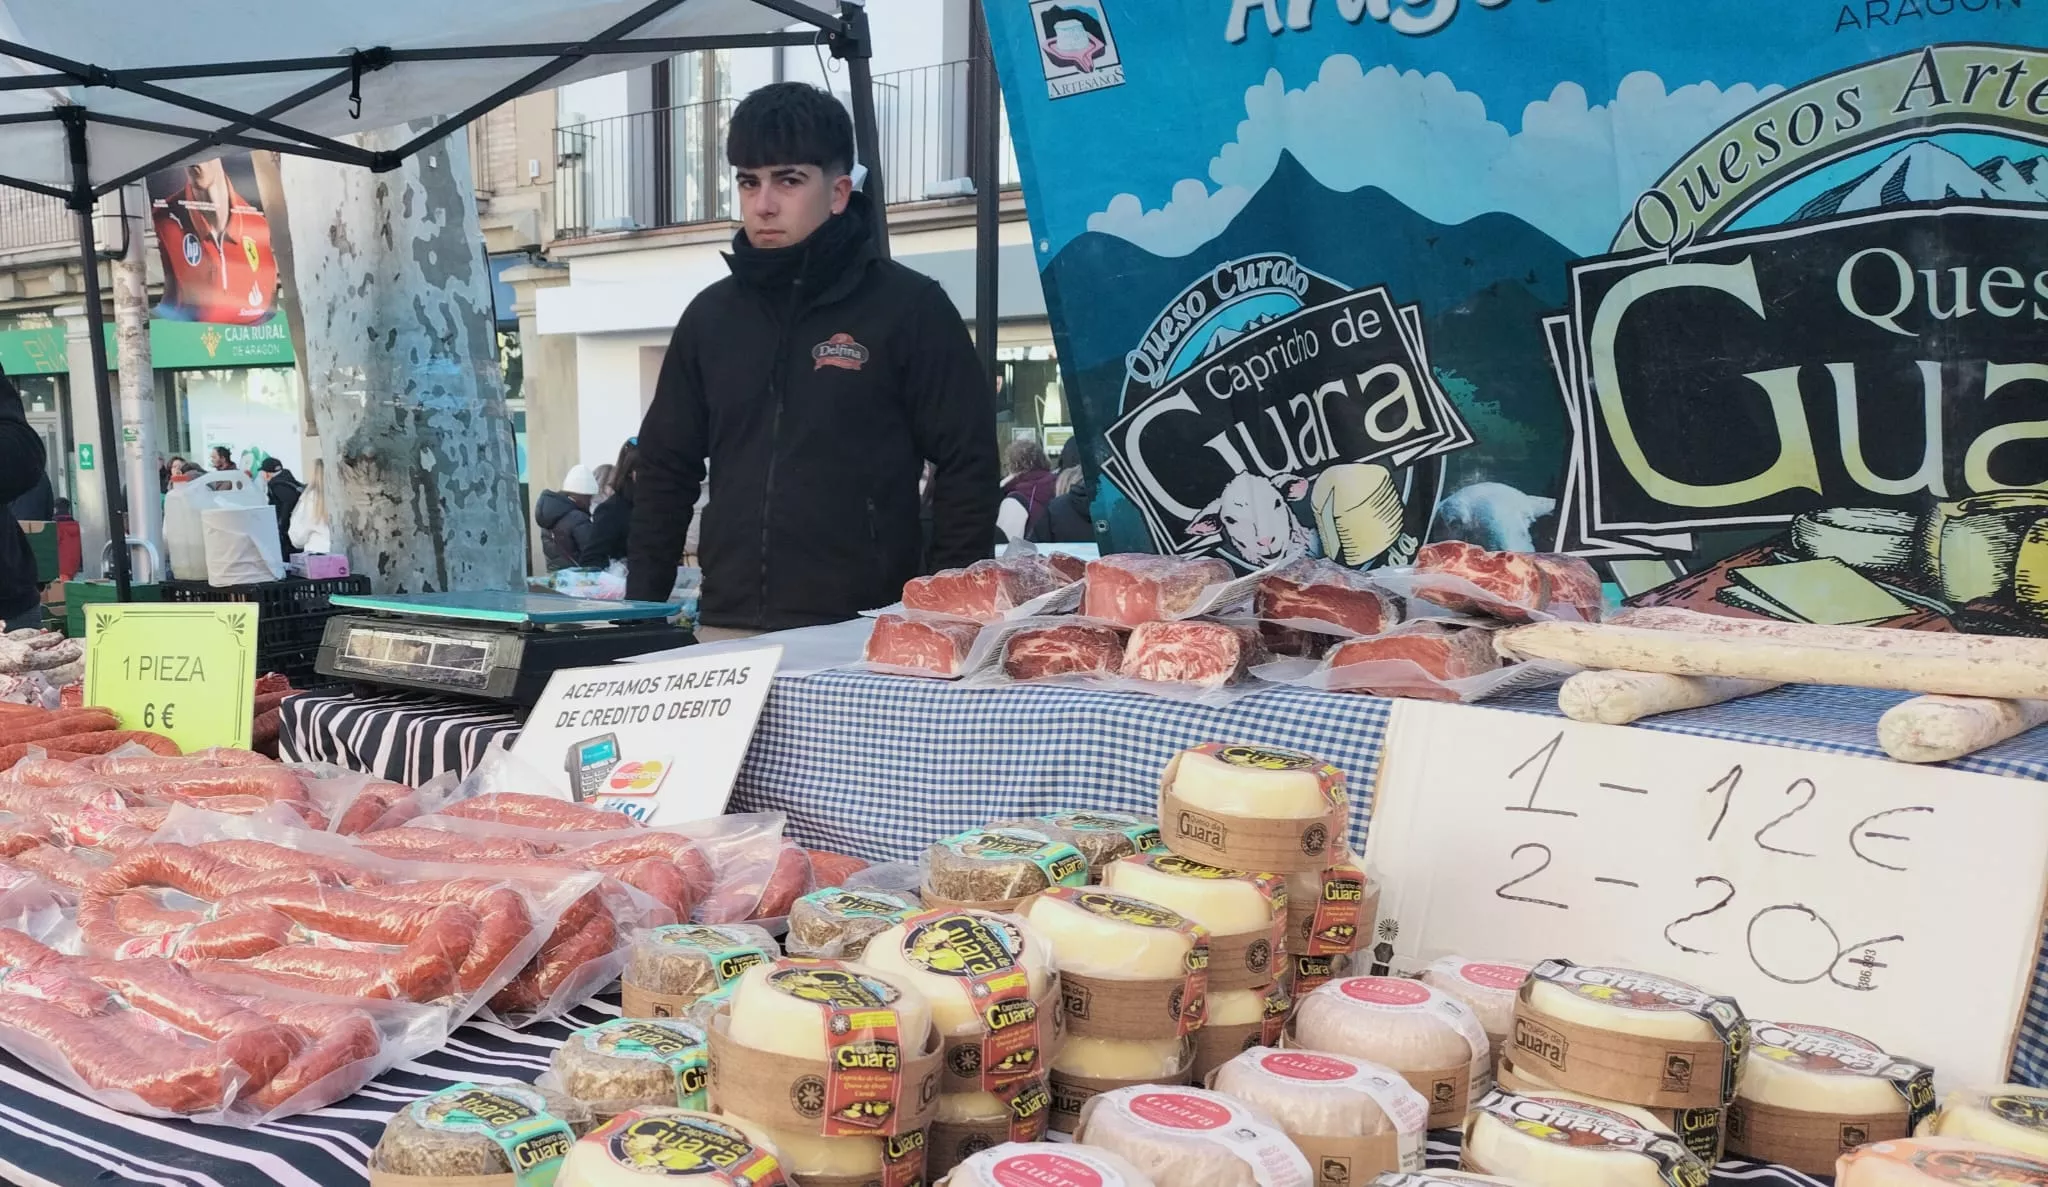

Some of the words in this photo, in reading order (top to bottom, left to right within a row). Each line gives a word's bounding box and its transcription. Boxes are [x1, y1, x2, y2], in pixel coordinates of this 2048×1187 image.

[1634, 85, 1862, 264] Quesos
[224, 327, 251, 342] CAJA
[252, 323, 286, 341] RURAL
[1126, 292, 1207, 390] Queso
[1213, 256, 1309, 300] Curado
[232, 346, 244, 356] DE
[1205, 330, 1320, 401] Capricho
[1331, 307, 1382, 348] de
[1125, 363, 1427, 521] Guara
[123, 655, 130, 680] 1
[139, 655, 206, 682] PIEZA
[562, 676, 663, 699] ACEPTAMOS
[664, 666, 751, 692] TARJETAS
[144, 702, 155, 728] 6
[161, 702, 175, 729] €
[555, 711, 580, 728] DE
[580, 704, 650, 727] CREDITO
[652, 703, 664, 721] O
[667, 698, 732, 720] DEBITO
[1505, 731, 1578, 817] 1
[1179, 811, 1221, 846] Guara
[1049, 858, 1085, 881] Guara
[1496, 843, 1568, 909] 2
[1325, 881, 1361, 900] Guara
[934, 915, 997, 975] Guara
[1350, 981, 1421, 999] Guara
[986, 1004, 1035, 1030] Guara
[1525, 1021, 1550, 1038] Queso
[1551, 1032, 1563, 1043] de
[1514, 1018, 1561, 1062] Guara
[1756, 1026, 1875, 1070] Guara
[837, 1045, 897, 1067] Guara
[1273, 1056, 1345, 1077] Guara
[1011, 1092, 1048, 1117] Guara
[1145, 1096, 1215, 1127] Guara
[1510, 1100, 1638, 1146] Guara
[515, 1138, 573, 1168] Guara
[628, 1116, 739, 1167] Guara
[677, 1125, 730, 1147] Capricho
[730, 1140, 749, 1155] de
[888, 1131, 924, 1158] Guara
[1010, 1160, 1083, 1187] Guar
